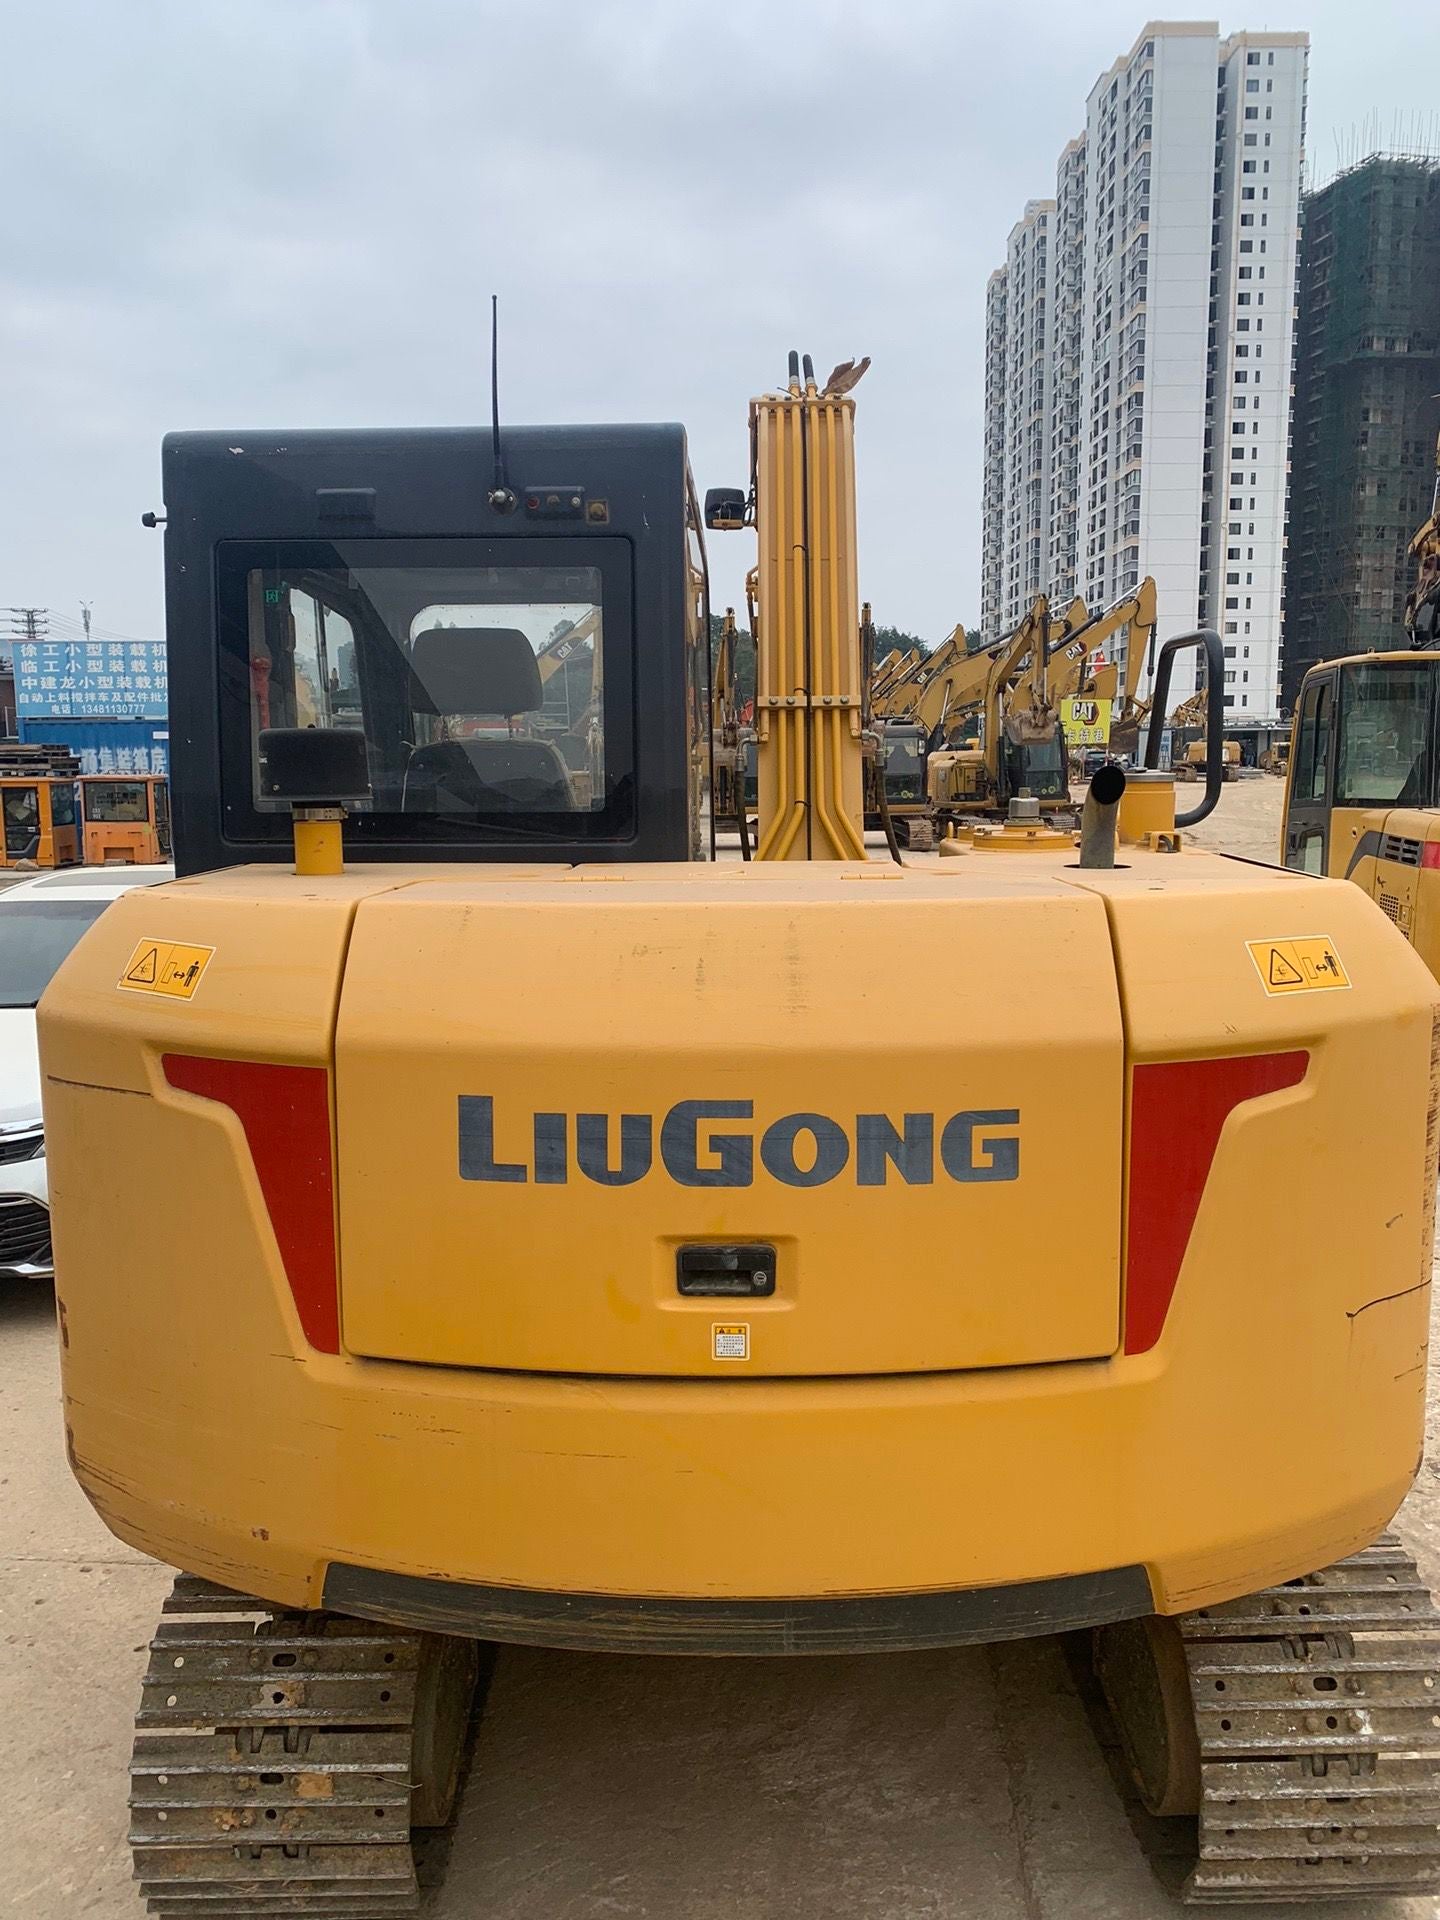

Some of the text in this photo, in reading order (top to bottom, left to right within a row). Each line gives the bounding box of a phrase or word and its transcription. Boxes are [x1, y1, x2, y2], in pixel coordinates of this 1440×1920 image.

[557, 642, 573, 659] CAT
[1066, 642, 1083, 660] CAT
[21, 660, 168, 673] 临工小型装载机
[1072, 701, 1094, 721] CAT
